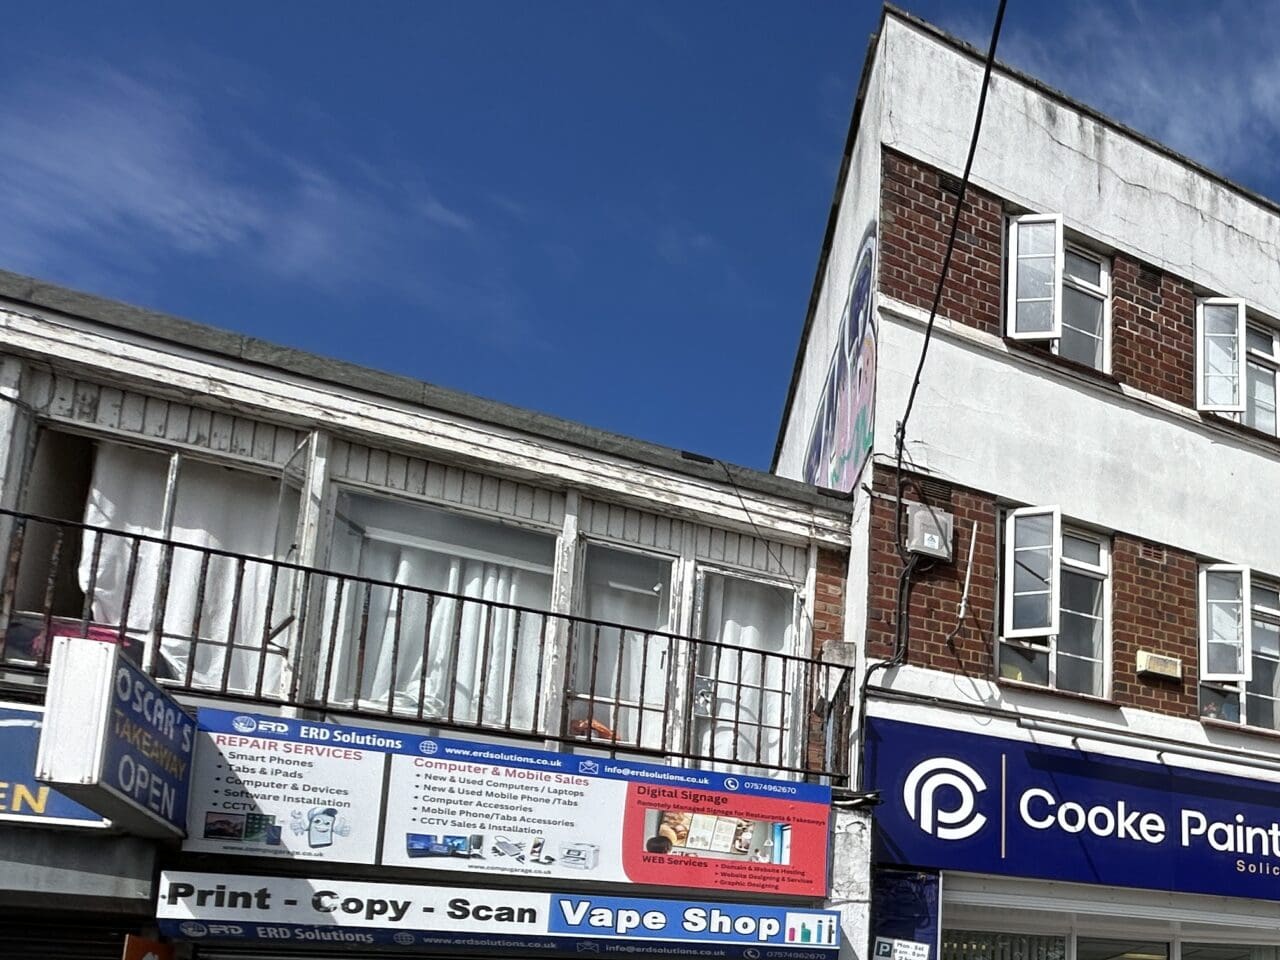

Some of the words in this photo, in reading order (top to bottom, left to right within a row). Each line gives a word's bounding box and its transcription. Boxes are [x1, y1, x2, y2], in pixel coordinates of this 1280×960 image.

[115, 668, 192, 752] OSCAR'S
[113, 709, 186, 781] TAKEAWAY
[300, 725, 330, 740] ERD
[333, 730, 402, 749] Solutions
[216, 735, 279, 752] REPAIR
[283, 743, 363, 760] SERVICES
[444, 746, 562, 767] www.erdsolutions.co.uk
[228, 752, 266, 763] Smart
[269, 756, 314, 768] Phones
[227, 764, 256, 775] Tabs
[258, 767, 267, 775] &
[270, 768, 304, 779] iPads
[414, 757, 488, 775] Computer
[491, 767, 501, 776] &
[505, 768, 550, 782] Mobile
[554, 774, 590, 787] Sales
[604, 765, 710, 785] info@erdsolutions.co.uk
[118, 755, 176, 820] OPEN
[225, 776, 288, 791] Computer
[290, 782, 299, 790] &
[302, 783, 349, 796] Devices
[423, 784, 446, 793] New
[458, 787, 483, 797] Used
[485, 791, 518, 801] Mobile
[521, 794, 550, 804] Phone
[424, 773, 446, 783] New
[458, 777, 483, 786] Used
[486, 779, 539, 793] Computers
[547, 786, 585, 798] Laptops
[637, 786, 678, 800] Digital
[682, 790, 729, 805] Signage
[222, 801, 257, 812] CCTV
[224, 789, 280, 802] Software
[283, 794, 351, 808] Installation
[422, 795, 473, 808] Computer
[475, 801, 533, 813] Accessories
[421, 806, 456, 816] Mobile
[459, 809, 518, 823] Phone/Tabs
[519, 815, 575, 828] Accessories
[672, 803, 705, 814] Managed
[706, 807, 733, 817] Signage
[1019, 787, 1166, 844] Cooke
[420, 817, 448, 826] CCTV
[451, 820, 477, 829] Sales
[488, 823, 543, 835] Installation
[642, 855, 665, 865] WEB
[667, 857, 708, 868] Services
[167, 882, 271, 909] Print
[312, 890, 411, 921] Copy
[447, 898, 537, 923] Scan
[559, 899, 667, 934] Vape
[682, 907, 780, 941] Shop
[256, 926, 291, 939] ERD
[296, 928, 374, 943] Solutions
[423, 936, 557, 949] www.erdsolutions.co.uk
[605, 944, 725, 957] info@erdsolutions.co.uk
[879, 943, 891, 955] P
